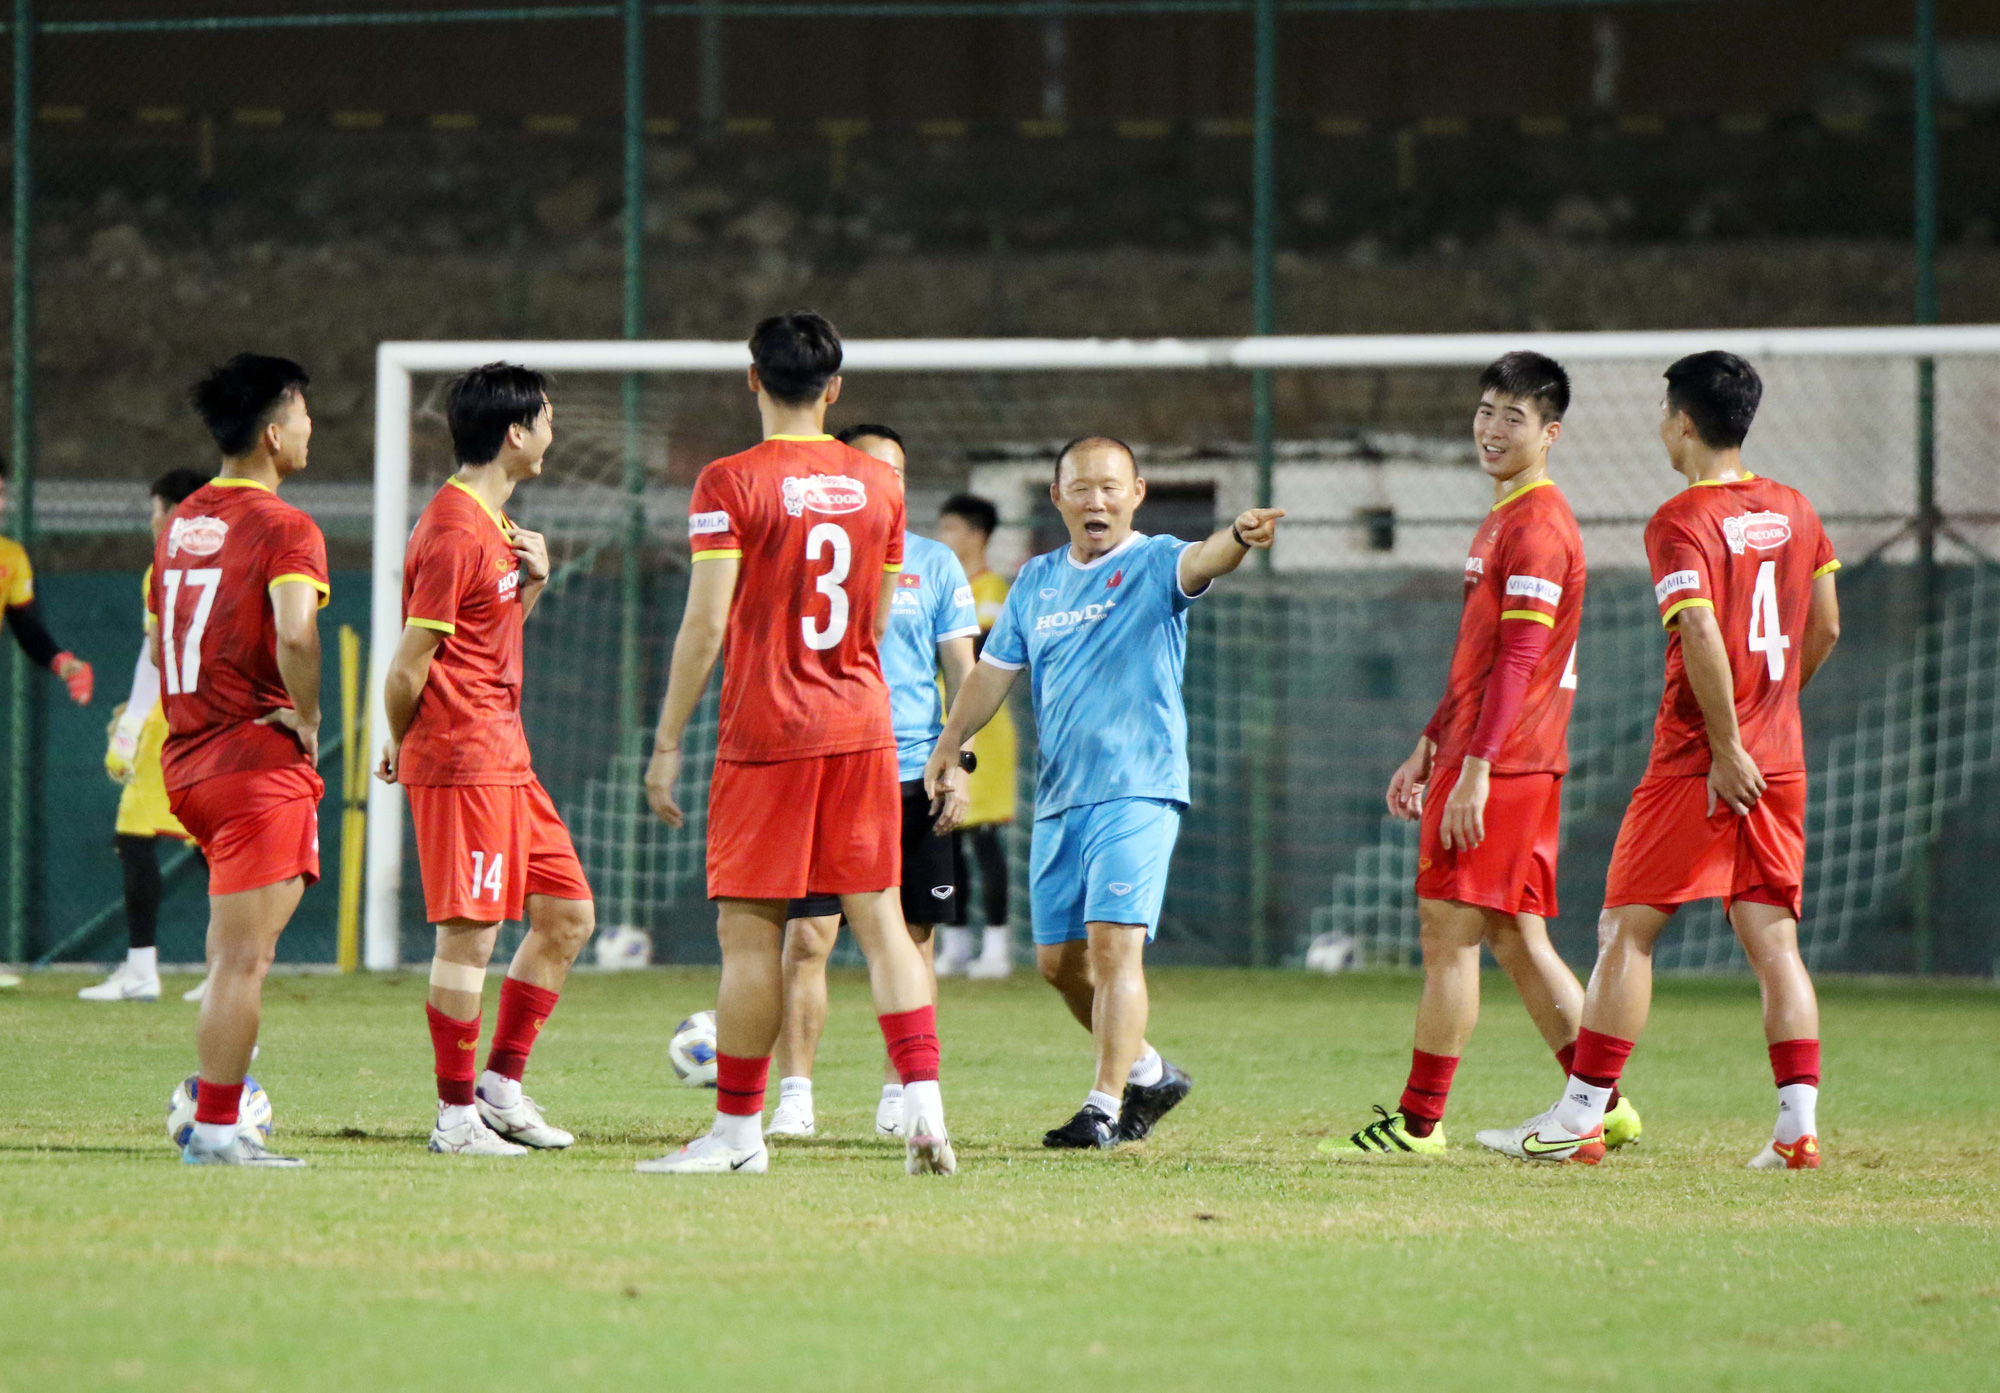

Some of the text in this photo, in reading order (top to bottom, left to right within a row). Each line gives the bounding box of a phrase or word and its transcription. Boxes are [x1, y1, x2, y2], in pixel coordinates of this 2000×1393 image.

[806, 493, 861, 505] ACCOOK
[163, 568, 223, 695] 17
[802, 523, 851, 650] 3
[1748, 561, 1790, 681] 4
[471, 850, 503, 902] 14
